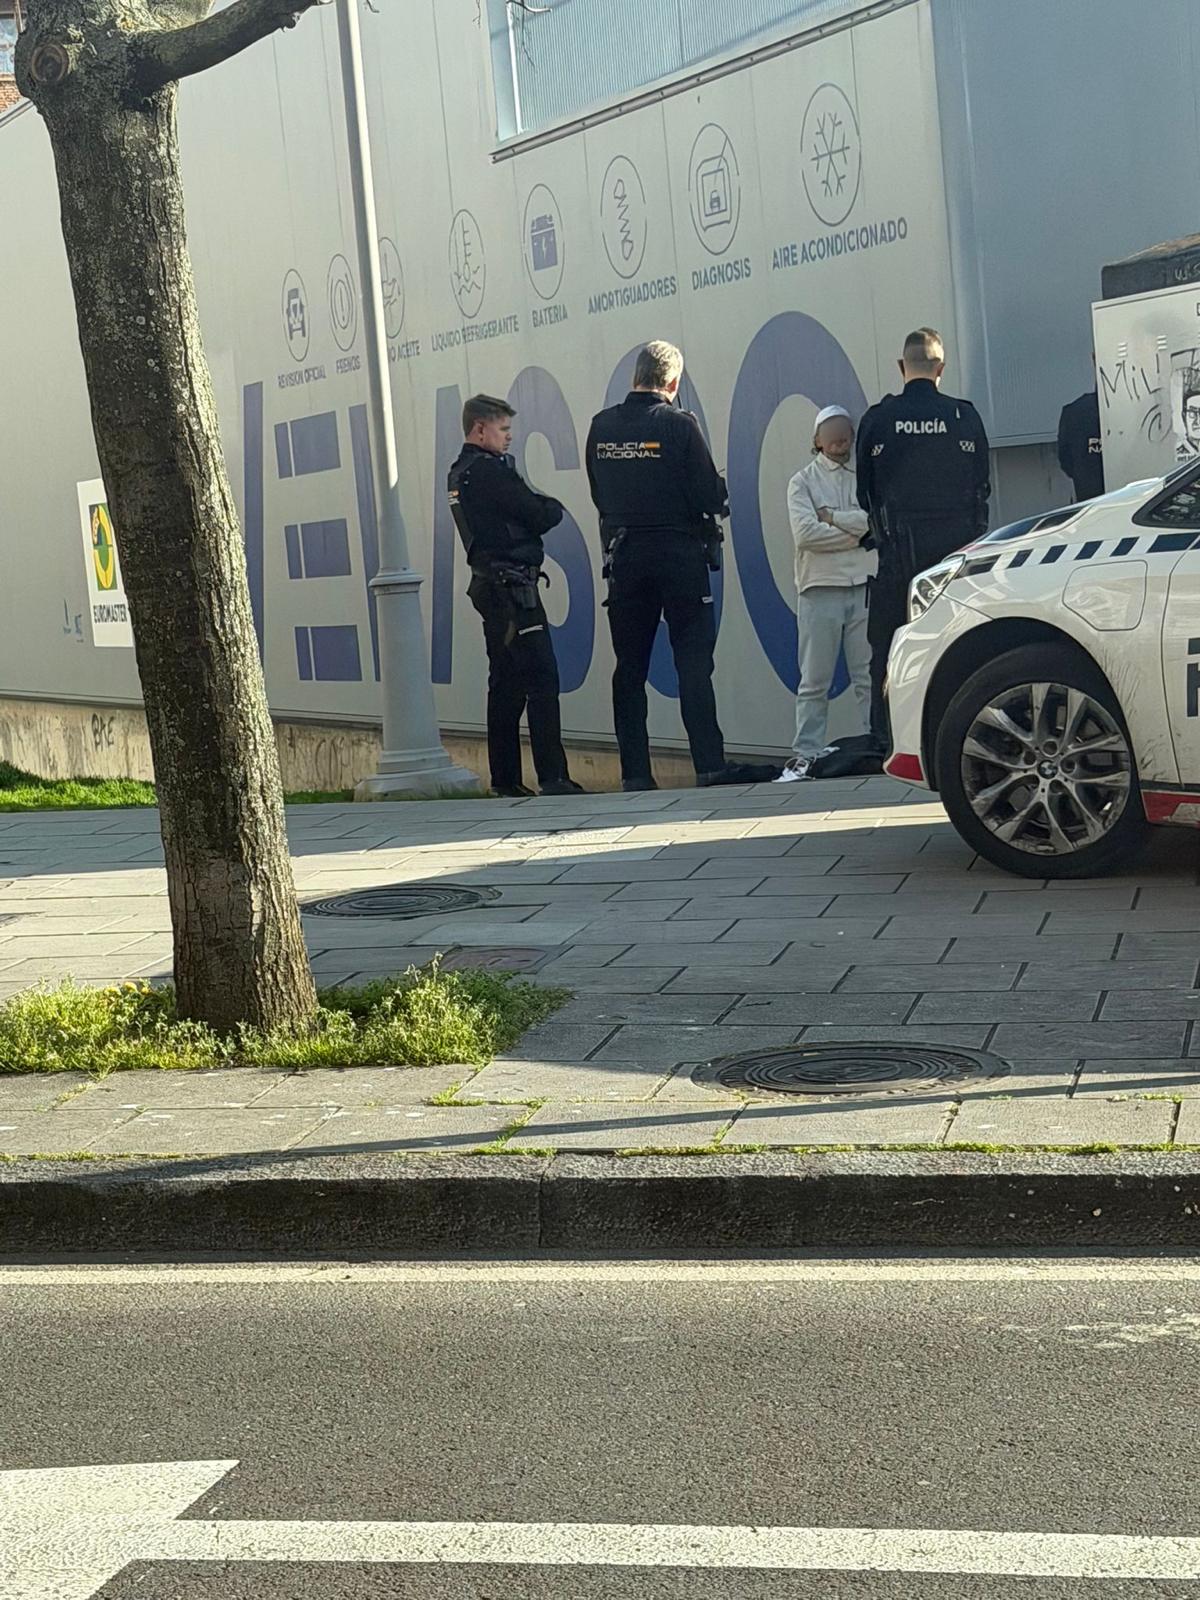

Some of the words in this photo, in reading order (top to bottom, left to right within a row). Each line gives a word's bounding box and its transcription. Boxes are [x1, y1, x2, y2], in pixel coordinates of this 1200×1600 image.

[772, 243, 798, 271] AIRE
[800, 216, 908, 265] ACONDICIONADO
[692, 257, 752, 291] DIAGNOSIS
[588, 275, 677, 314] AMORTIGUADORES
[532, 303, 569, 328] BATERIA
[461, 314, 520, 345] REFRIGERANTE
[397, 339, 421, 362] ACEITE
[895, 418, 948, 434] POLICÍA
[596, 450, 661, 460] NACIONAL
[597, 441, 646, 451] POLICIA
[93, 604, 128, 624] EUROMASTER
